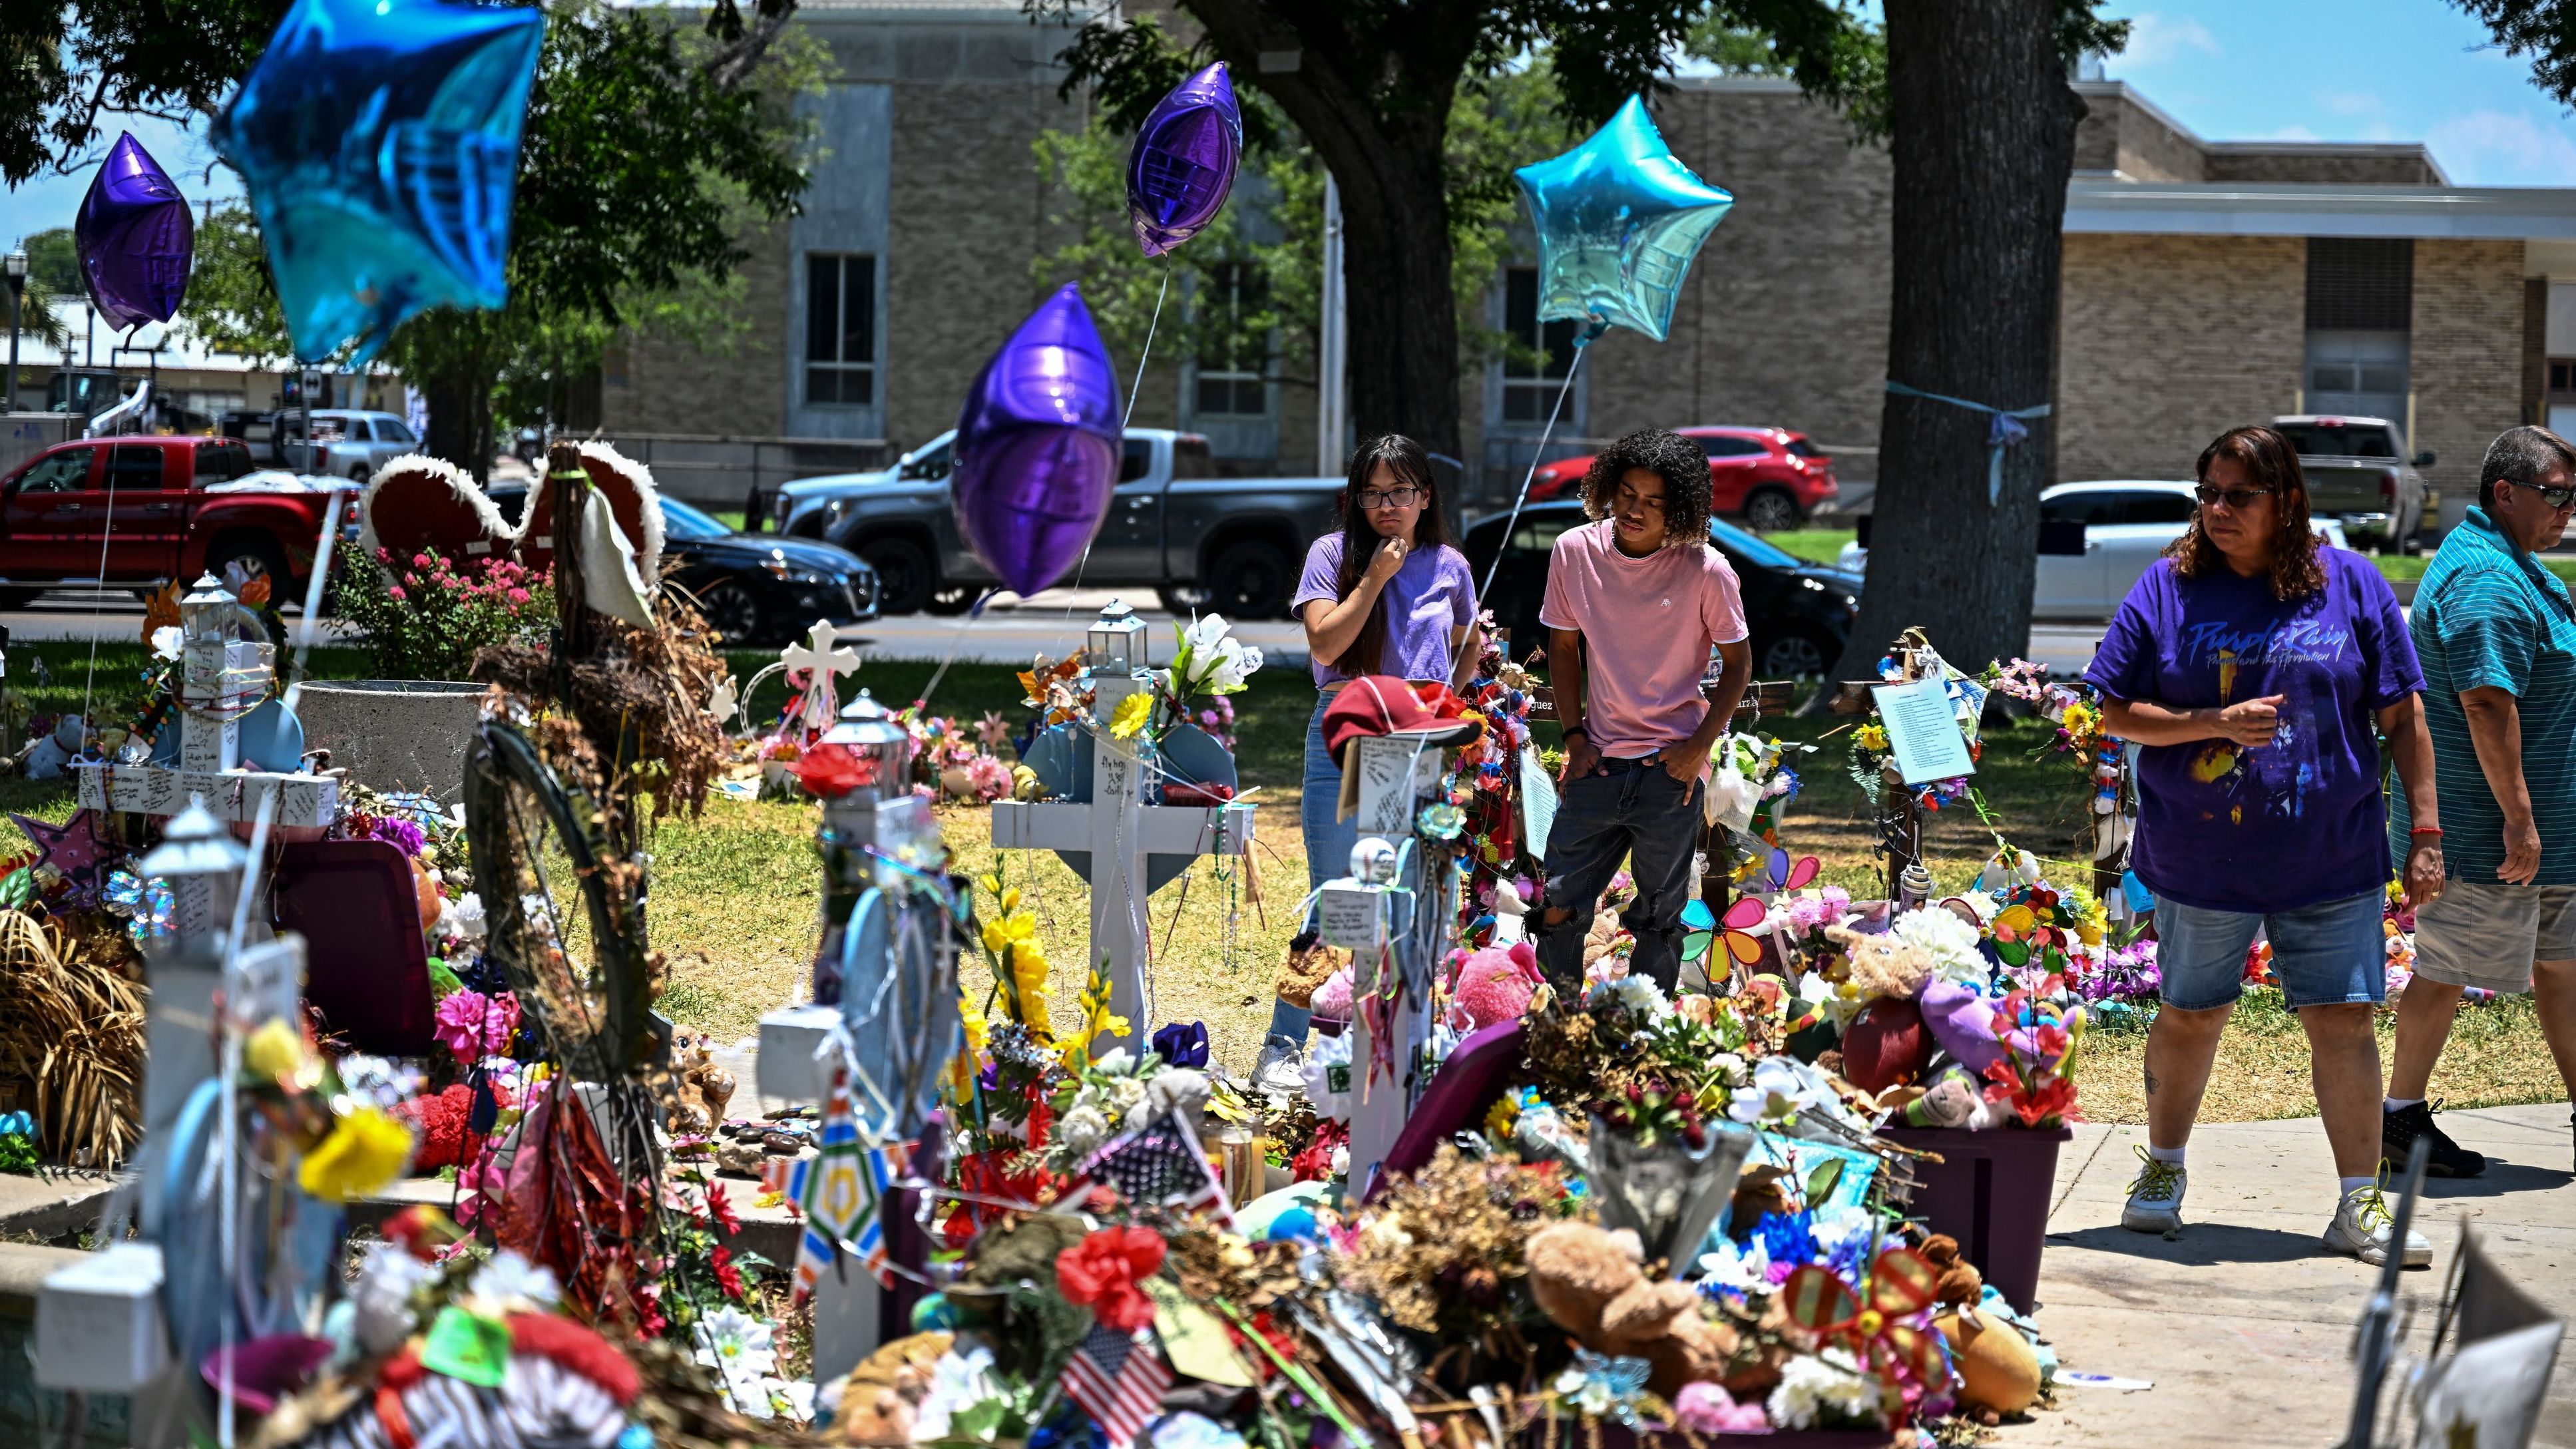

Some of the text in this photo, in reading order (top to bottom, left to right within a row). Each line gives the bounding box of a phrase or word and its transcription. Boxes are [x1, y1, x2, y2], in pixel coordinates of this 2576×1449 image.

[2188, 618, 2349, 666] Purple Rain
[2206, 654, 2239, 670] Prince
[2239, 656, 2258, 666] and
[2278, 648, 2330, 672] Revolution
[1457, 695, 1553, 712] nabe guez
[1737, 699, 1758, 708] arza
[1101, 755, 1112, 771] fly
